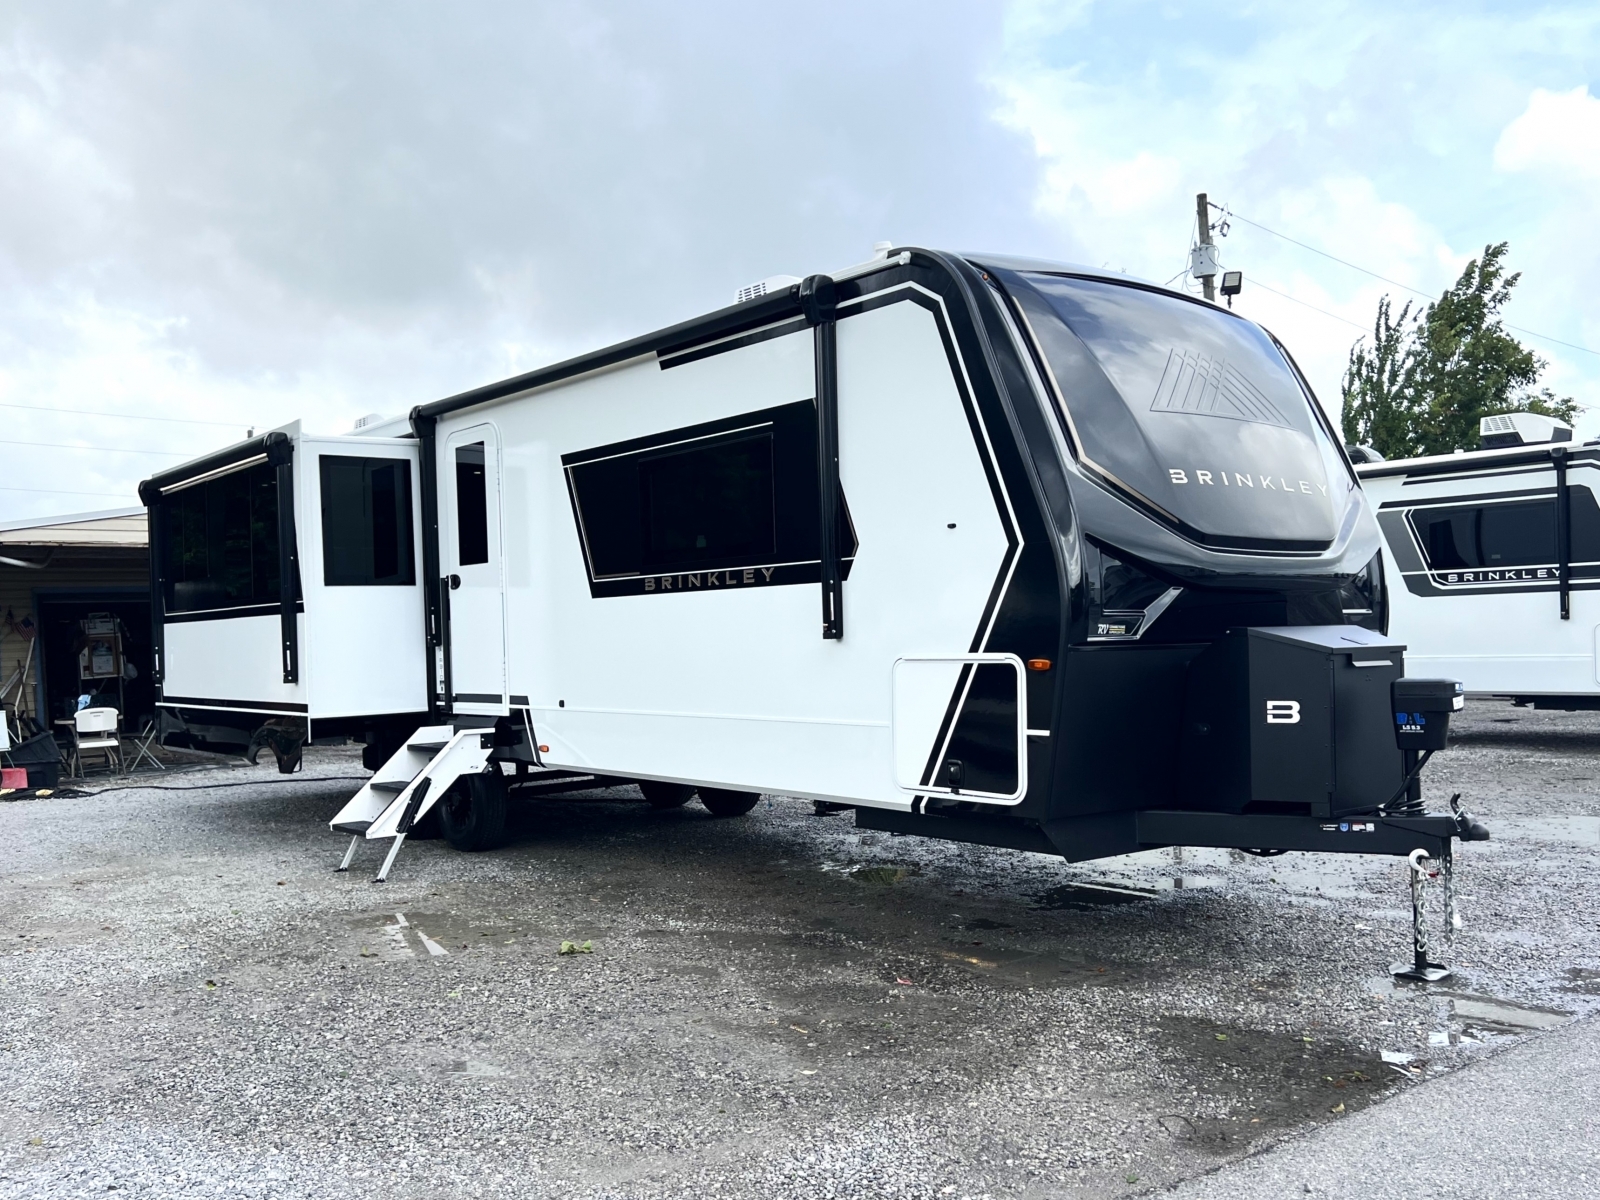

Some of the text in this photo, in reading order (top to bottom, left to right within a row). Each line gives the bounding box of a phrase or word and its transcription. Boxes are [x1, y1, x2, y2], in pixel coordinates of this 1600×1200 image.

[1168, 468, 1327, 497] BRINKLEY
[644, 567, 775, 591] BRINKLEY
[1447, 569, 1560, 582] BRINKLEY
[1097, 624, 1110, 635] RV
[1266, 700, 1301, 724] B
